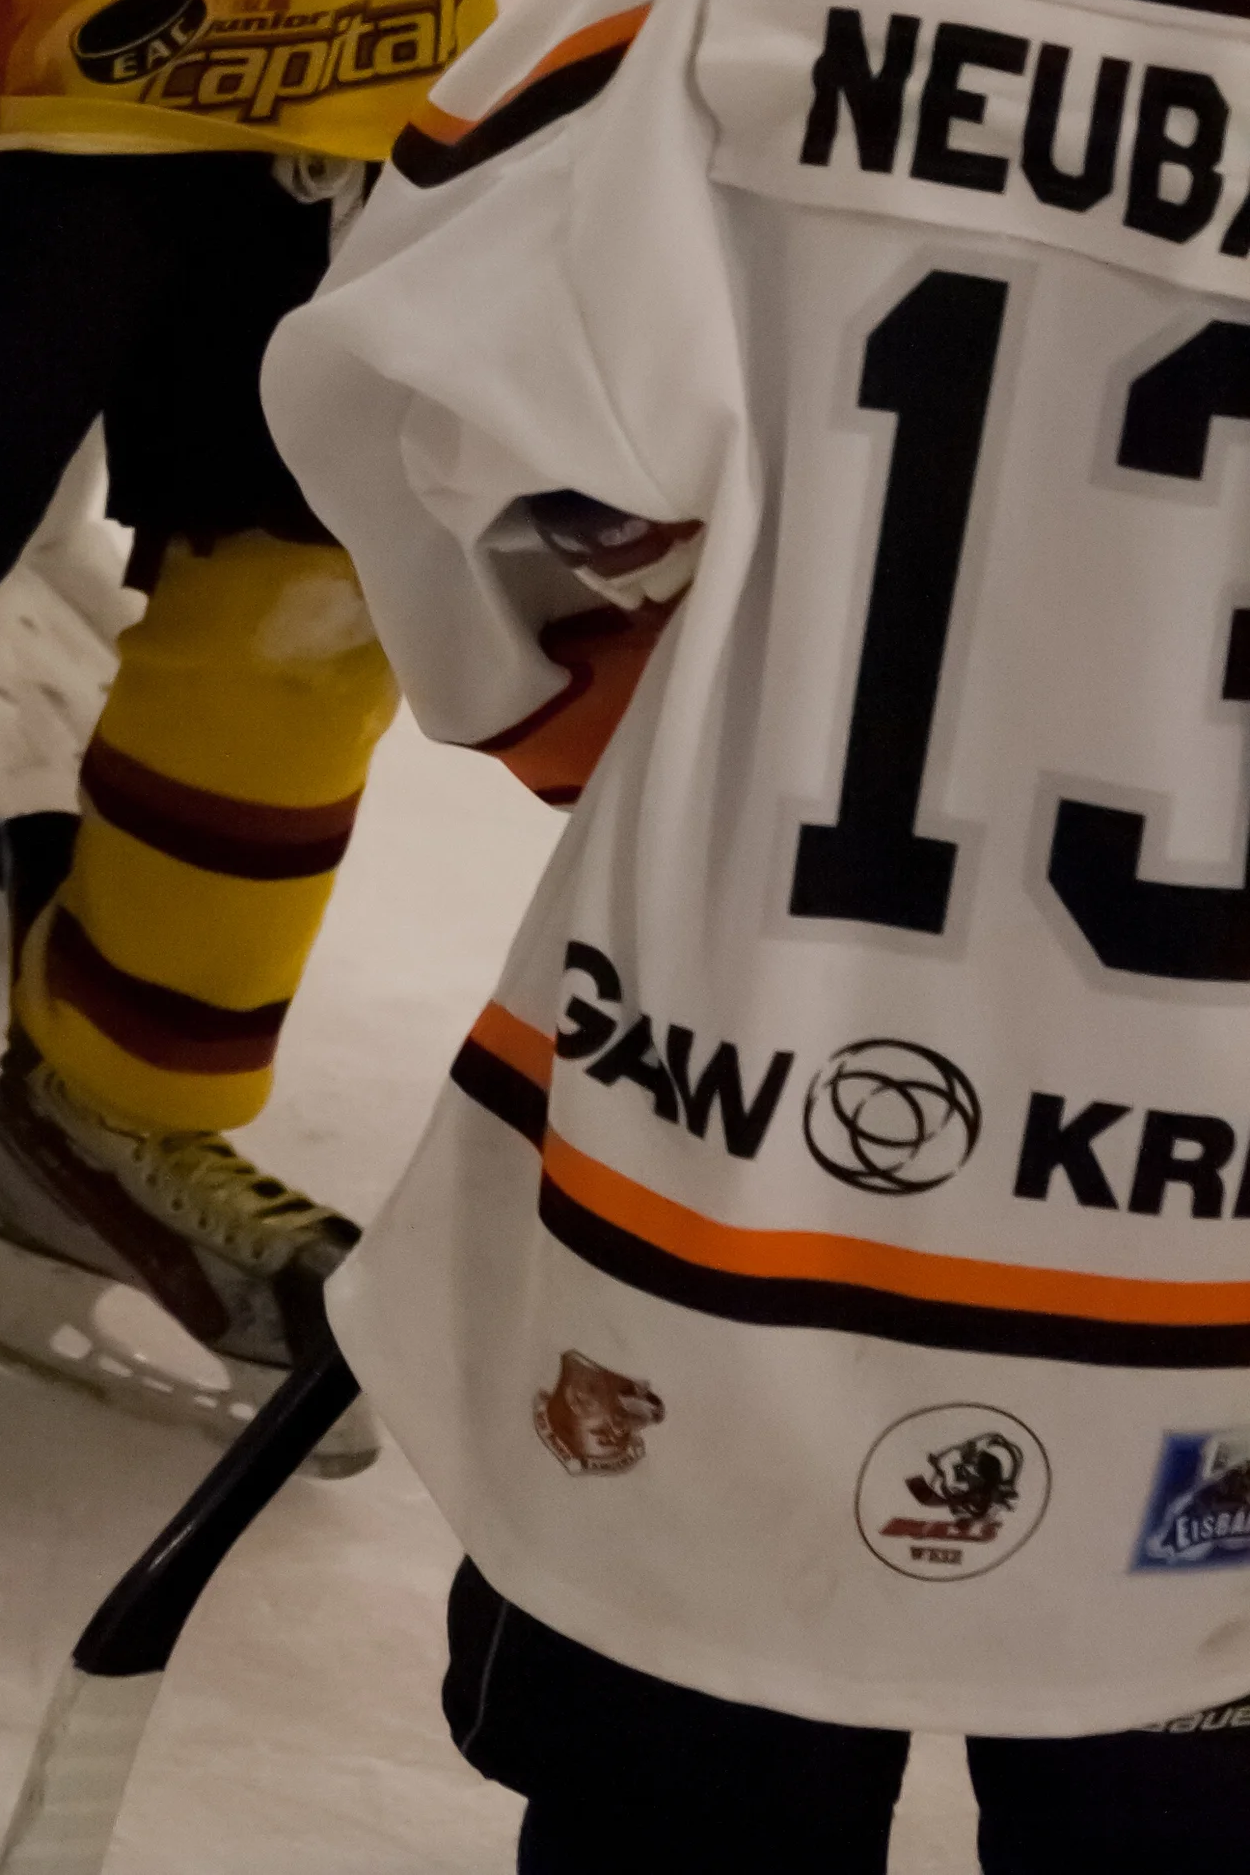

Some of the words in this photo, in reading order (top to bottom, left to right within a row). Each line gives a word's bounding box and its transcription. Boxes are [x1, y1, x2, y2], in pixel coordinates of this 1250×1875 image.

[799, 6, 1250, 258] NEUB
[790, 270, 1250, 981] 13
[555, 940, 795, 1159] GAW
[1014, 1091, 1250, 1219] KR
